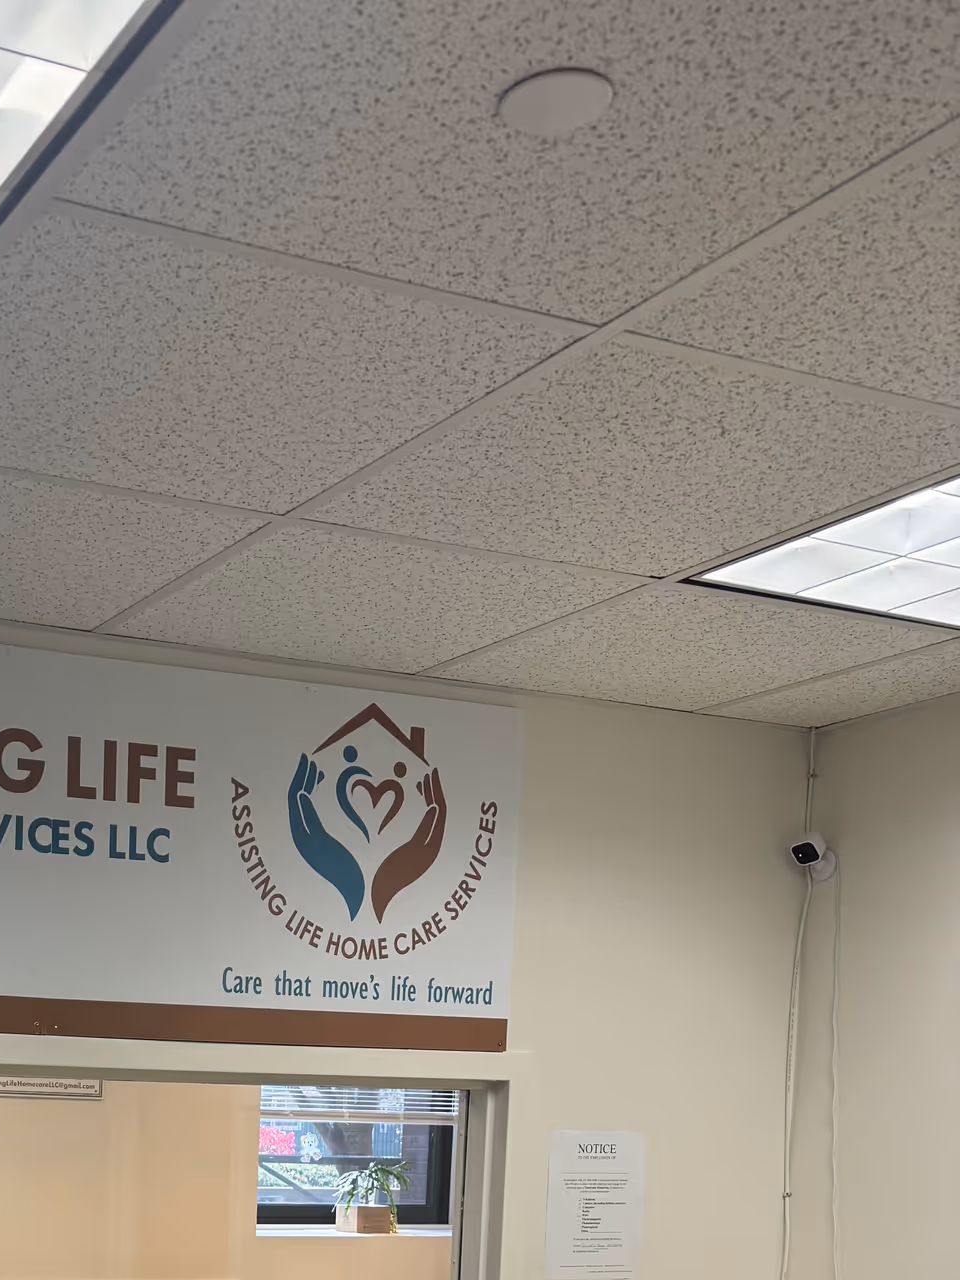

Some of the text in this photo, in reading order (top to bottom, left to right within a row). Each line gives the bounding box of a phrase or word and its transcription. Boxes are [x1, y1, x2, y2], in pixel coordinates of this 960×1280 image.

[66, 735, 196, 809] LIFE
[108, 824, 171, 863] LLC
[231, 777, 498, 960] ASSISTING LIFE HOME CARE SERVICES
[222, 966, 493, 1005] Care that move's life forward
[577, 1143, 617, 1154] NOTICE
